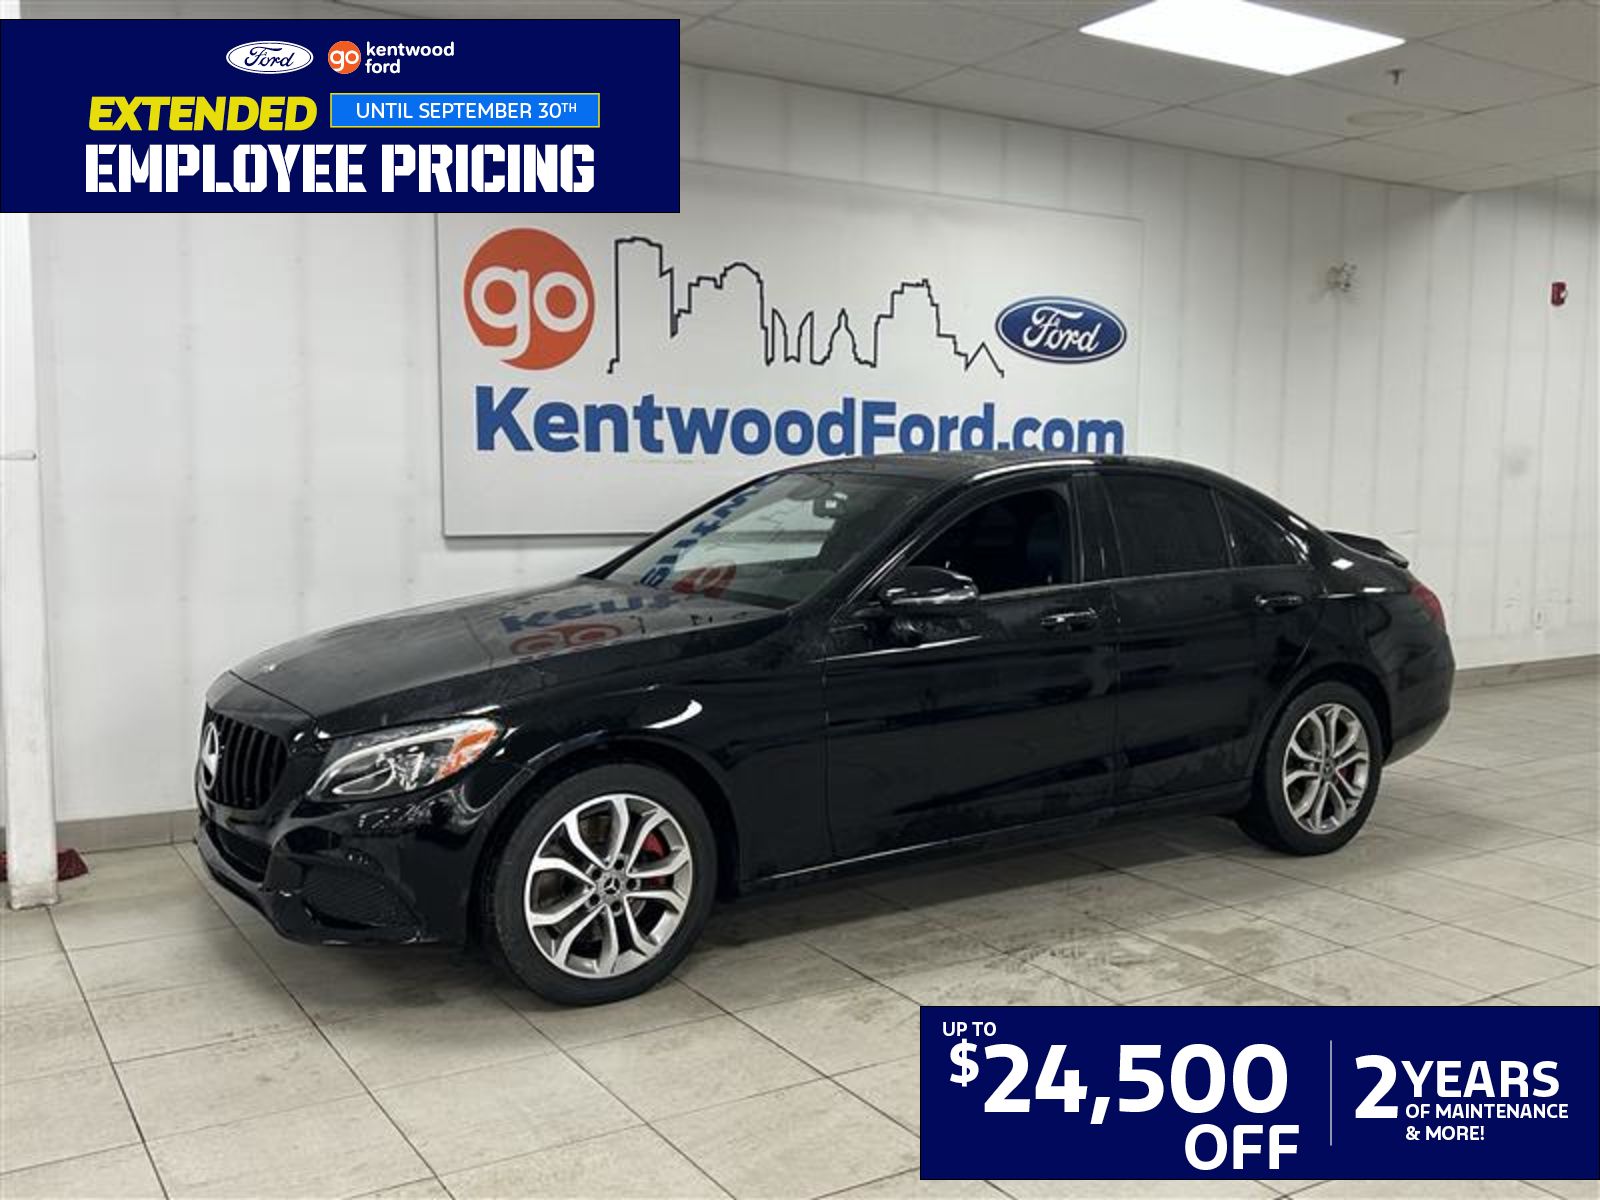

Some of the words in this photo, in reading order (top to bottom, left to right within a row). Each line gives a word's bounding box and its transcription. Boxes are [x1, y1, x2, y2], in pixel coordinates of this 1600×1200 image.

[471, 264, 590, 361] go
[1023, 305, 1102, 352] Ford
[475, 385, 1124, 454] KentwoodFord.com
